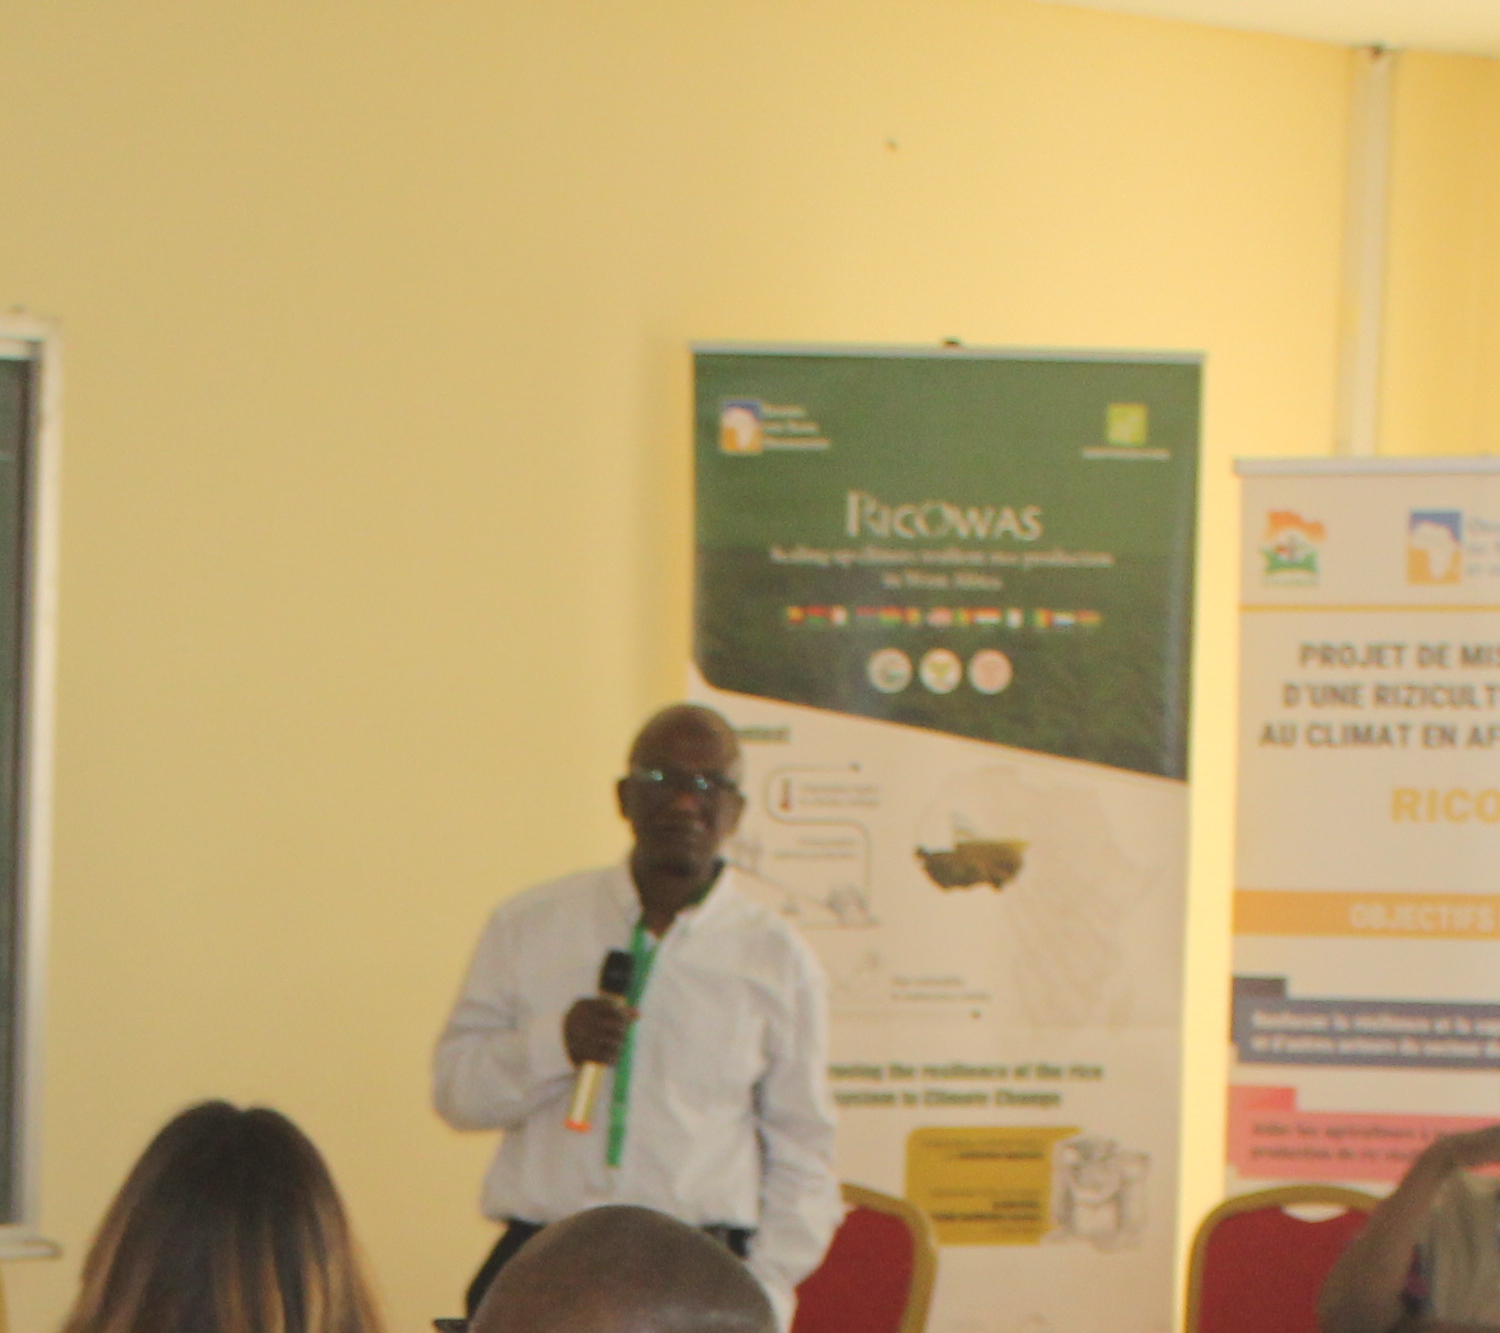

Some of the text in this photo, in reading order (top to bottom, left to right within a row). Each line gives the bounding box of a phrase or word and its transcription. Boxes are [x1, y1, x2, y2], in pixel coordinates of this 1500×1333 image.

[1298, 641, 1406, 669] PROJET
[1415, 643, 1453, 669] DE
[1282, 682, 1364, 709] D'UNE
[1258, 723, 1297, 748] AU
[1304, 723, 1413, 750] CLIMAT
[1420, 724, 1458, 750] EN
[1348, 903, 1495, 932] OBJECTIFS
